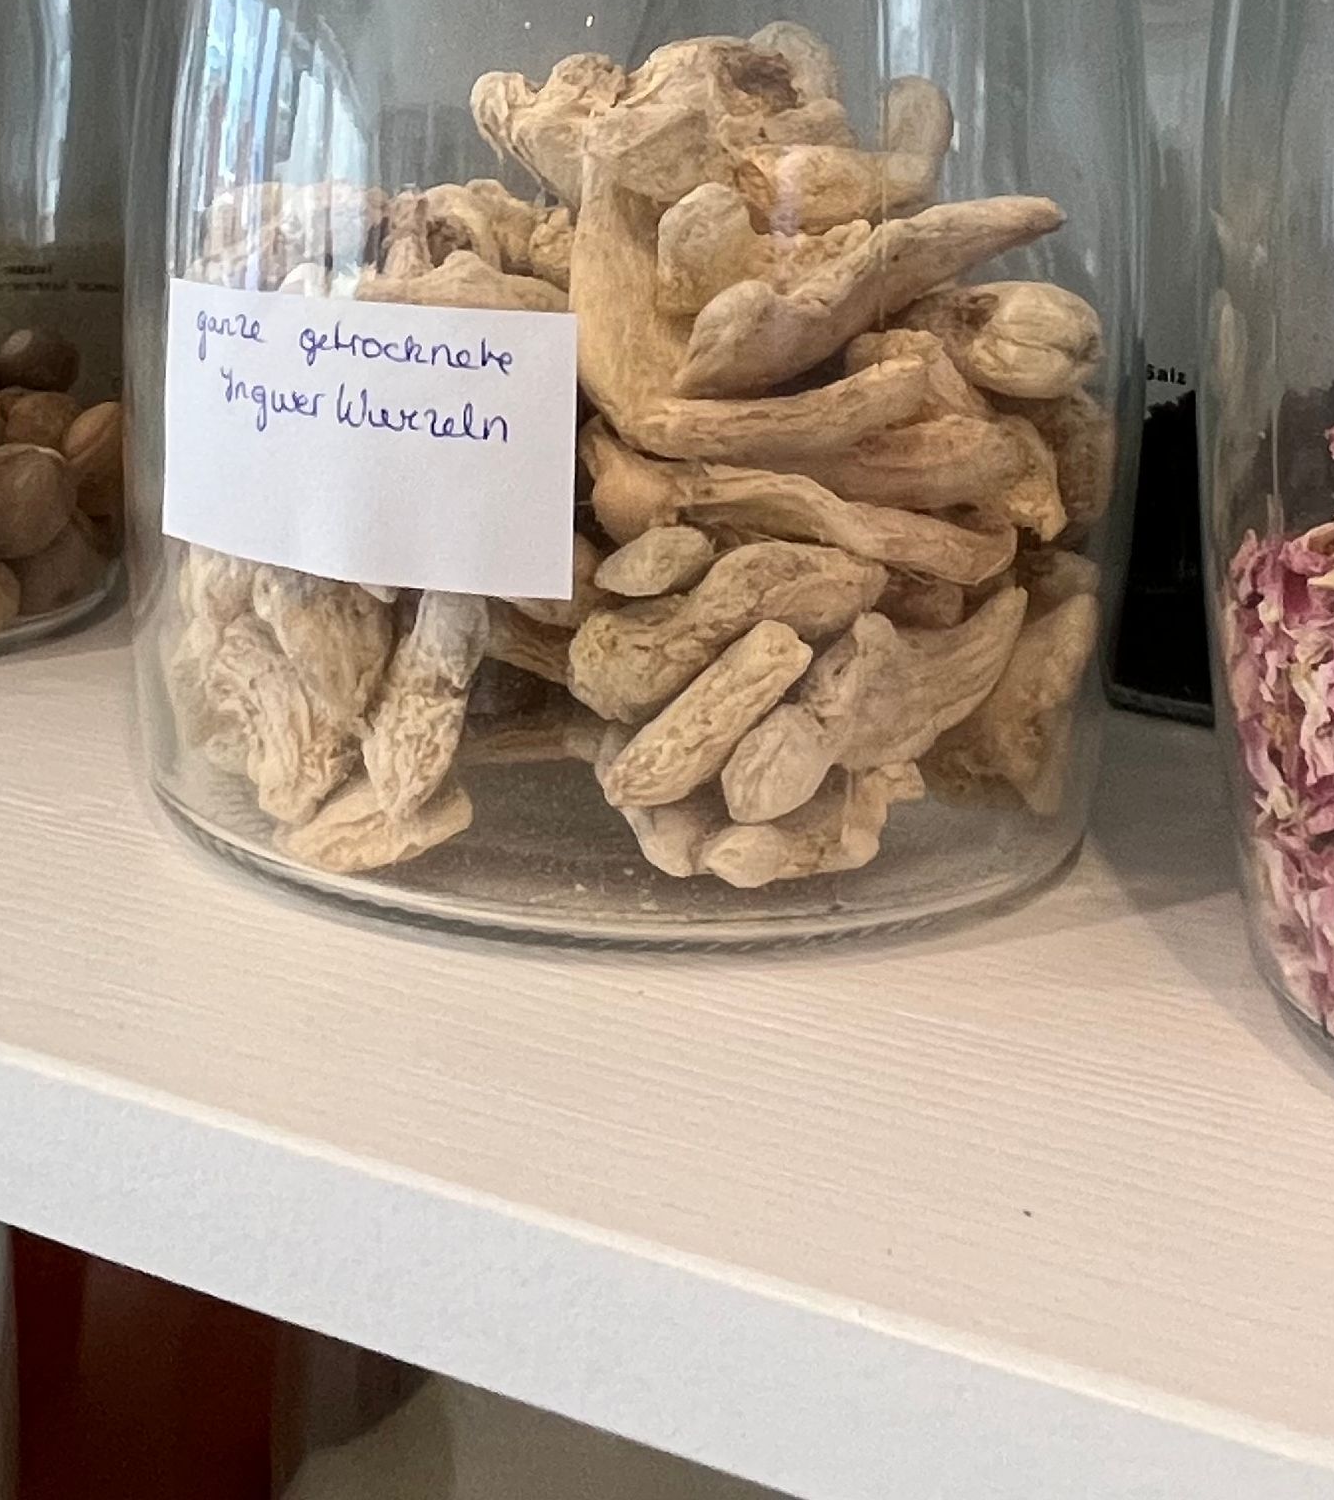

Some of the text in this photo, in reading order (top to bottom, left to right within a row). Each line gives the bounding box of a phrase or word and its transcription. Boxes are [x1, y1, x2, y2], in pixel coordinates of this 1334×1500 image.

[196, 308, 514, 376] ganze getrocknete
[220, 368, 509, 444] Ingwer Wurzeln
